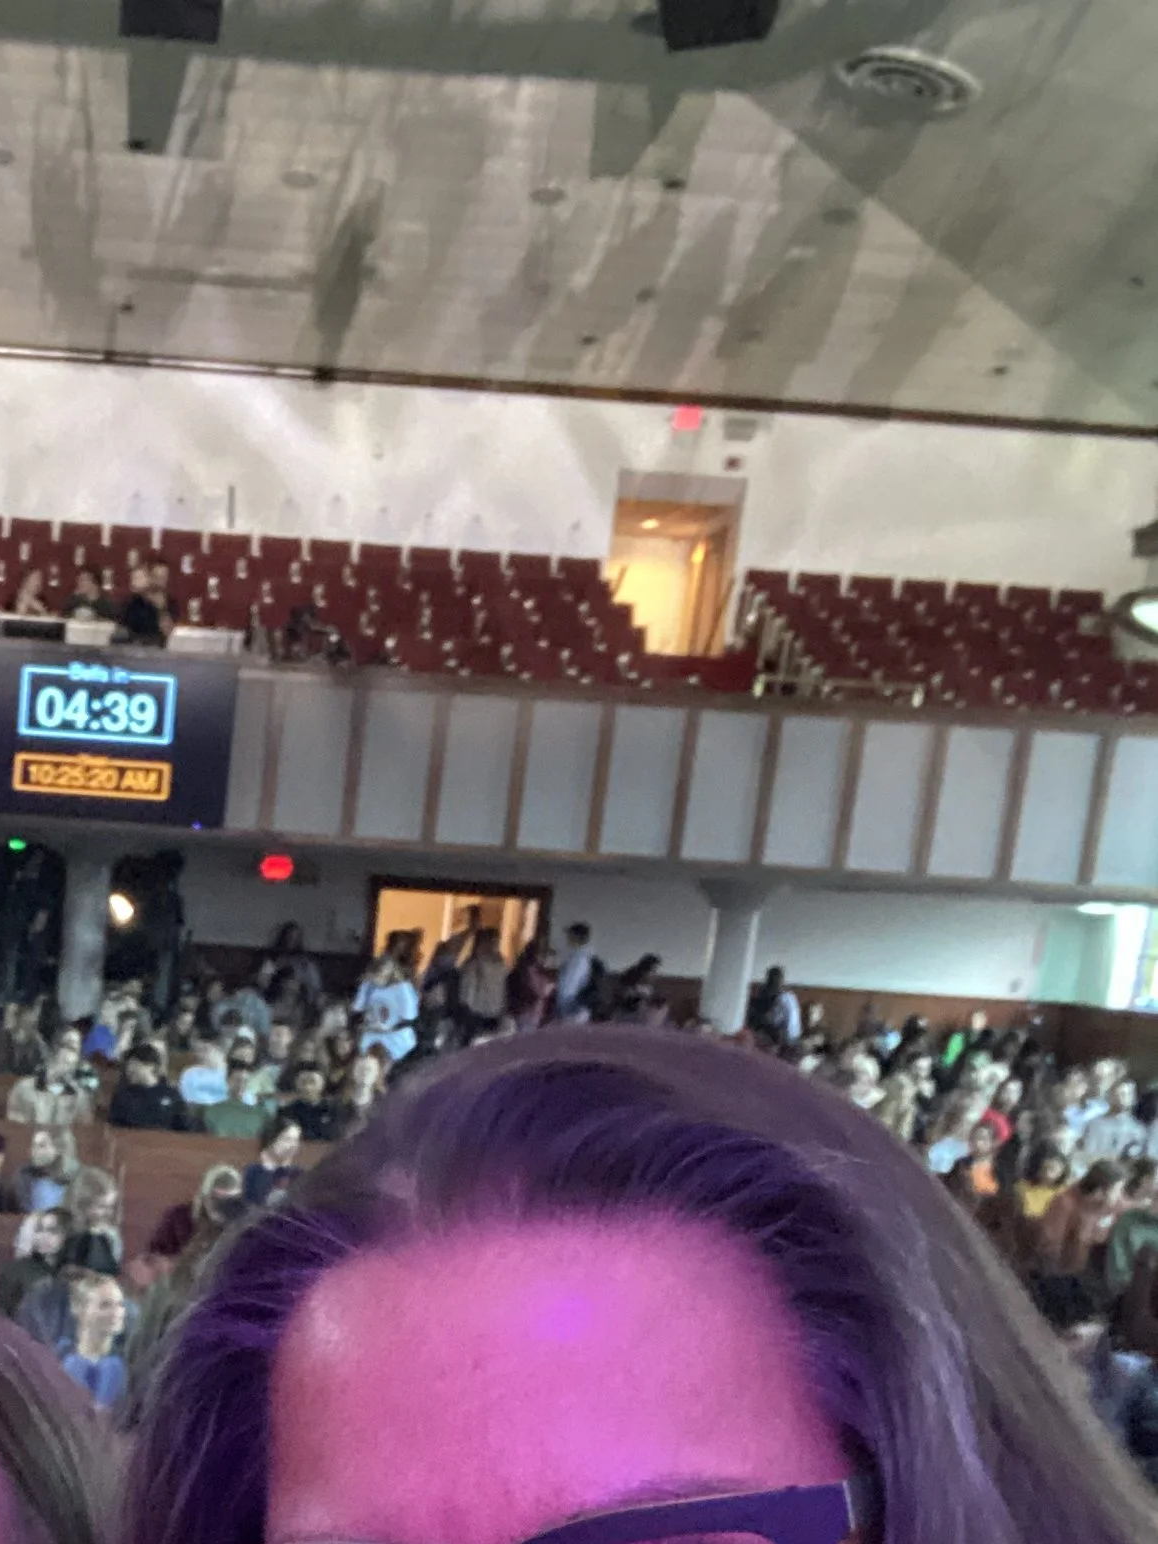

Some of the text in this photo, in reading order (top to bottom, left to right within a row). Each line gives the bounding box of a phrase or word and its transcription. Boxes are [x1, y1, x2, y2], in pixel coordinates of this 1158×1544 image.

[36, 686, 158, 733] 04:39
[28, 764, 159, 792] 10:25:20 AM
